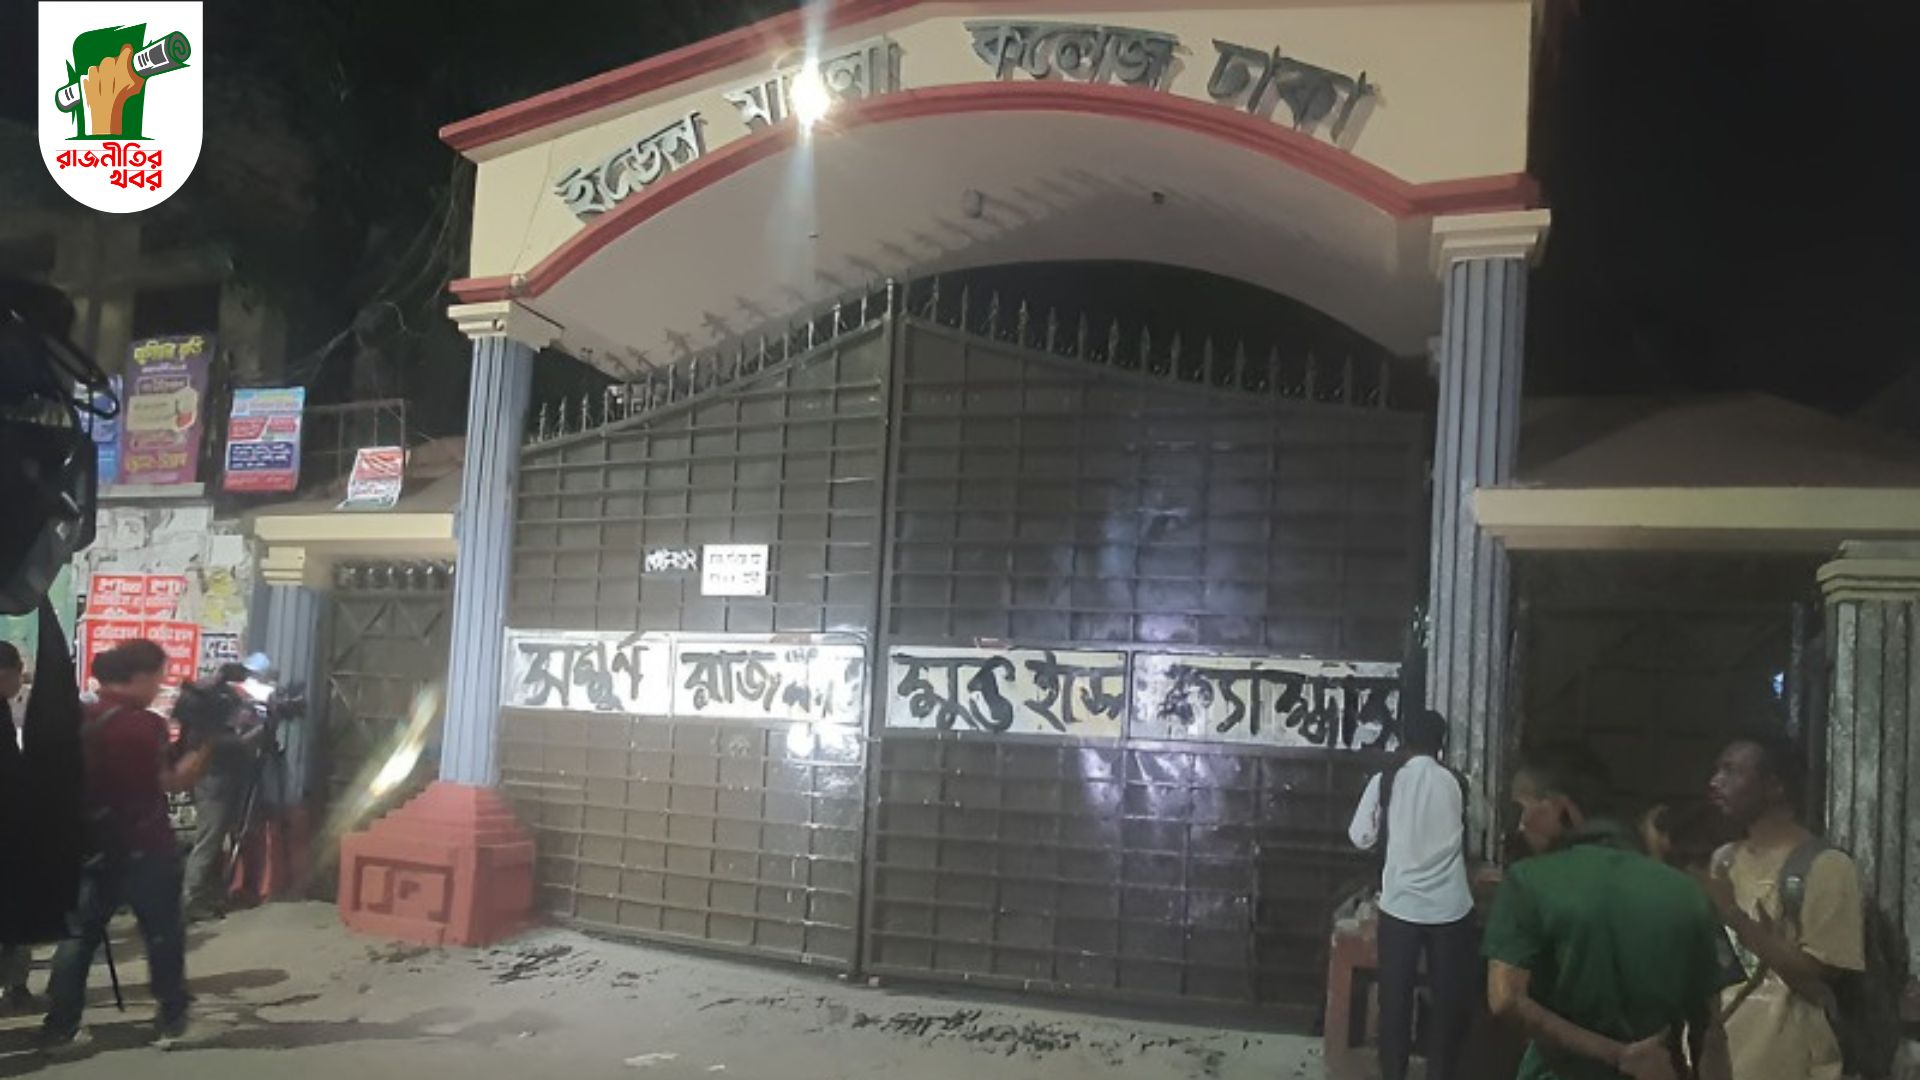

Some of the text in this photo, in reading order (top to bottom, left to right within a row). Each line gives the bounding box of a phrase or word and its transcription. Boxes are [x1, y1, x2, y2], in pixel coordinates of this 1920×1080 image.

[554, 19, 1377, 216] ইডেন মিলা কলেজ ঢাকা
